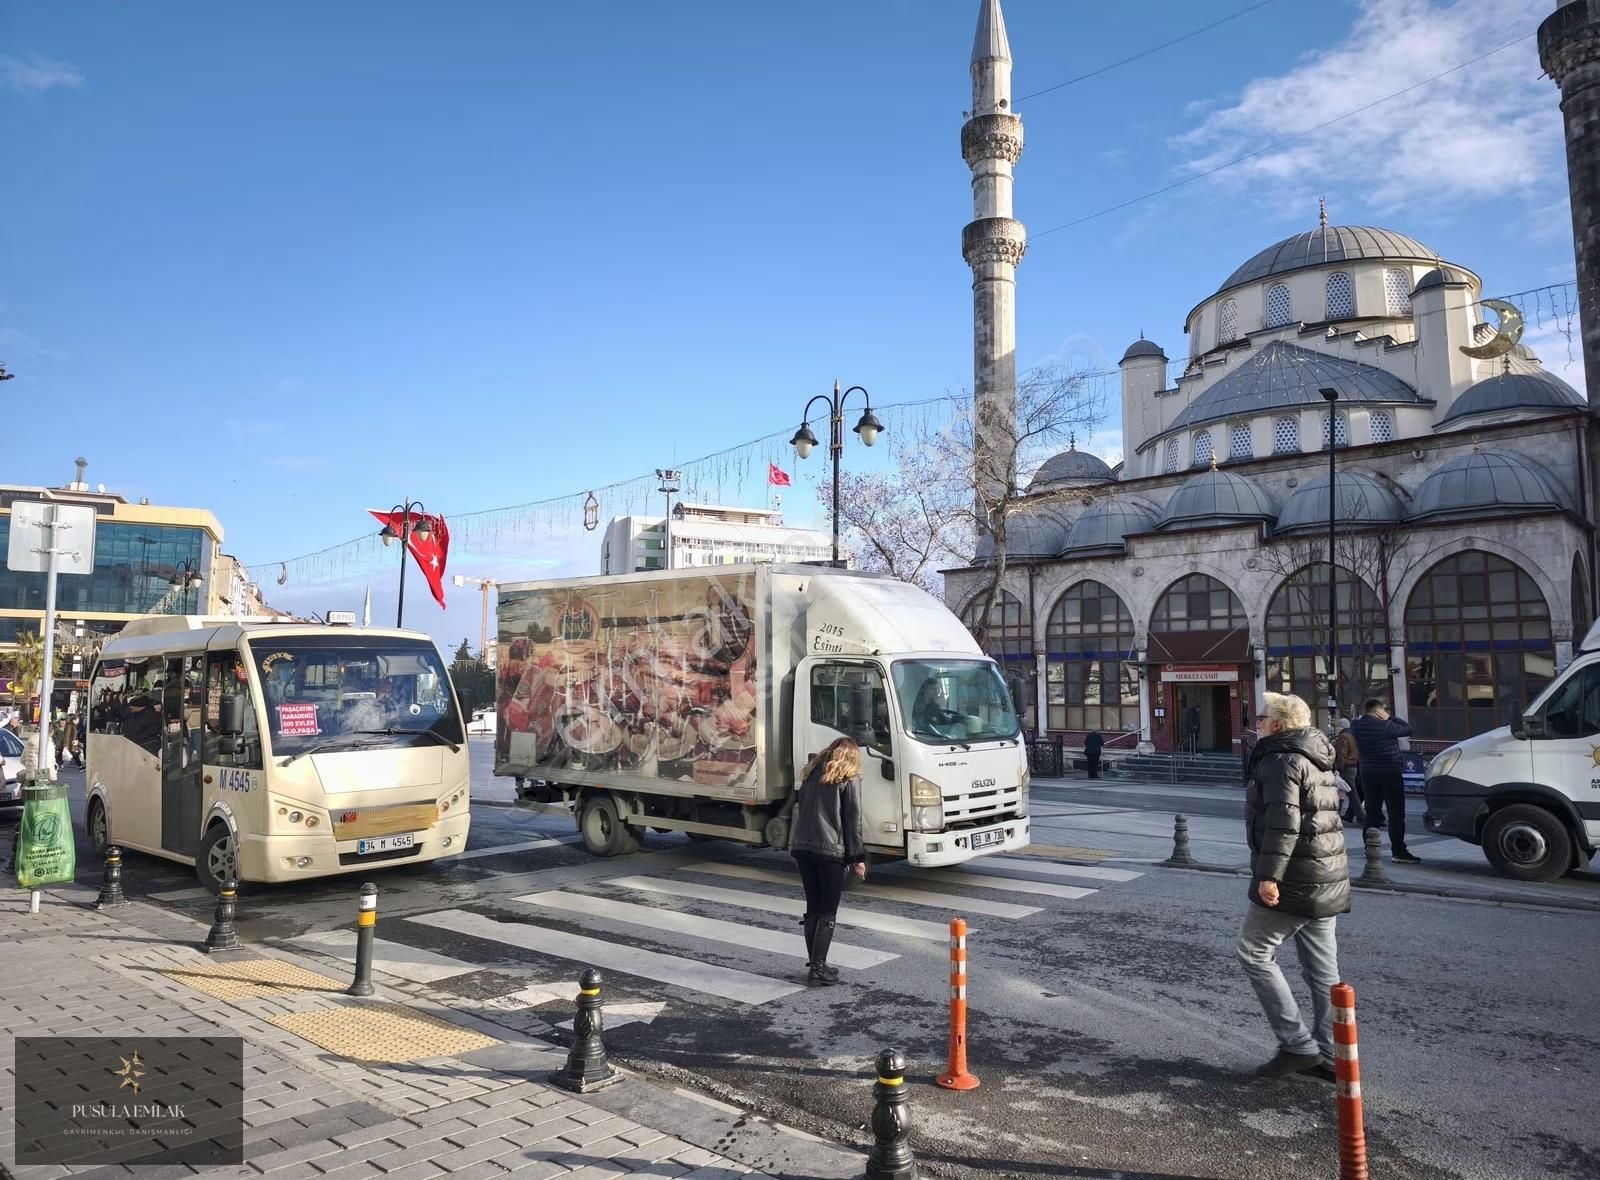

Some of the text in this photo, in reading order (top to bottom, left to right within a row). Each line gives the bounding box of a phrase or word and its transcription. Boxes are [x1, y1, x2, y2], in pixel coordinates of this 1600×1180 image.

[819, 623, 844, 637] 2015
[813, 635, 843, 653] Esinti
[219, 769, 250, 792] M 4545
[971, 777, 996, 788] ISUZU
[365, 836, 411, 851] 34 M 4545
